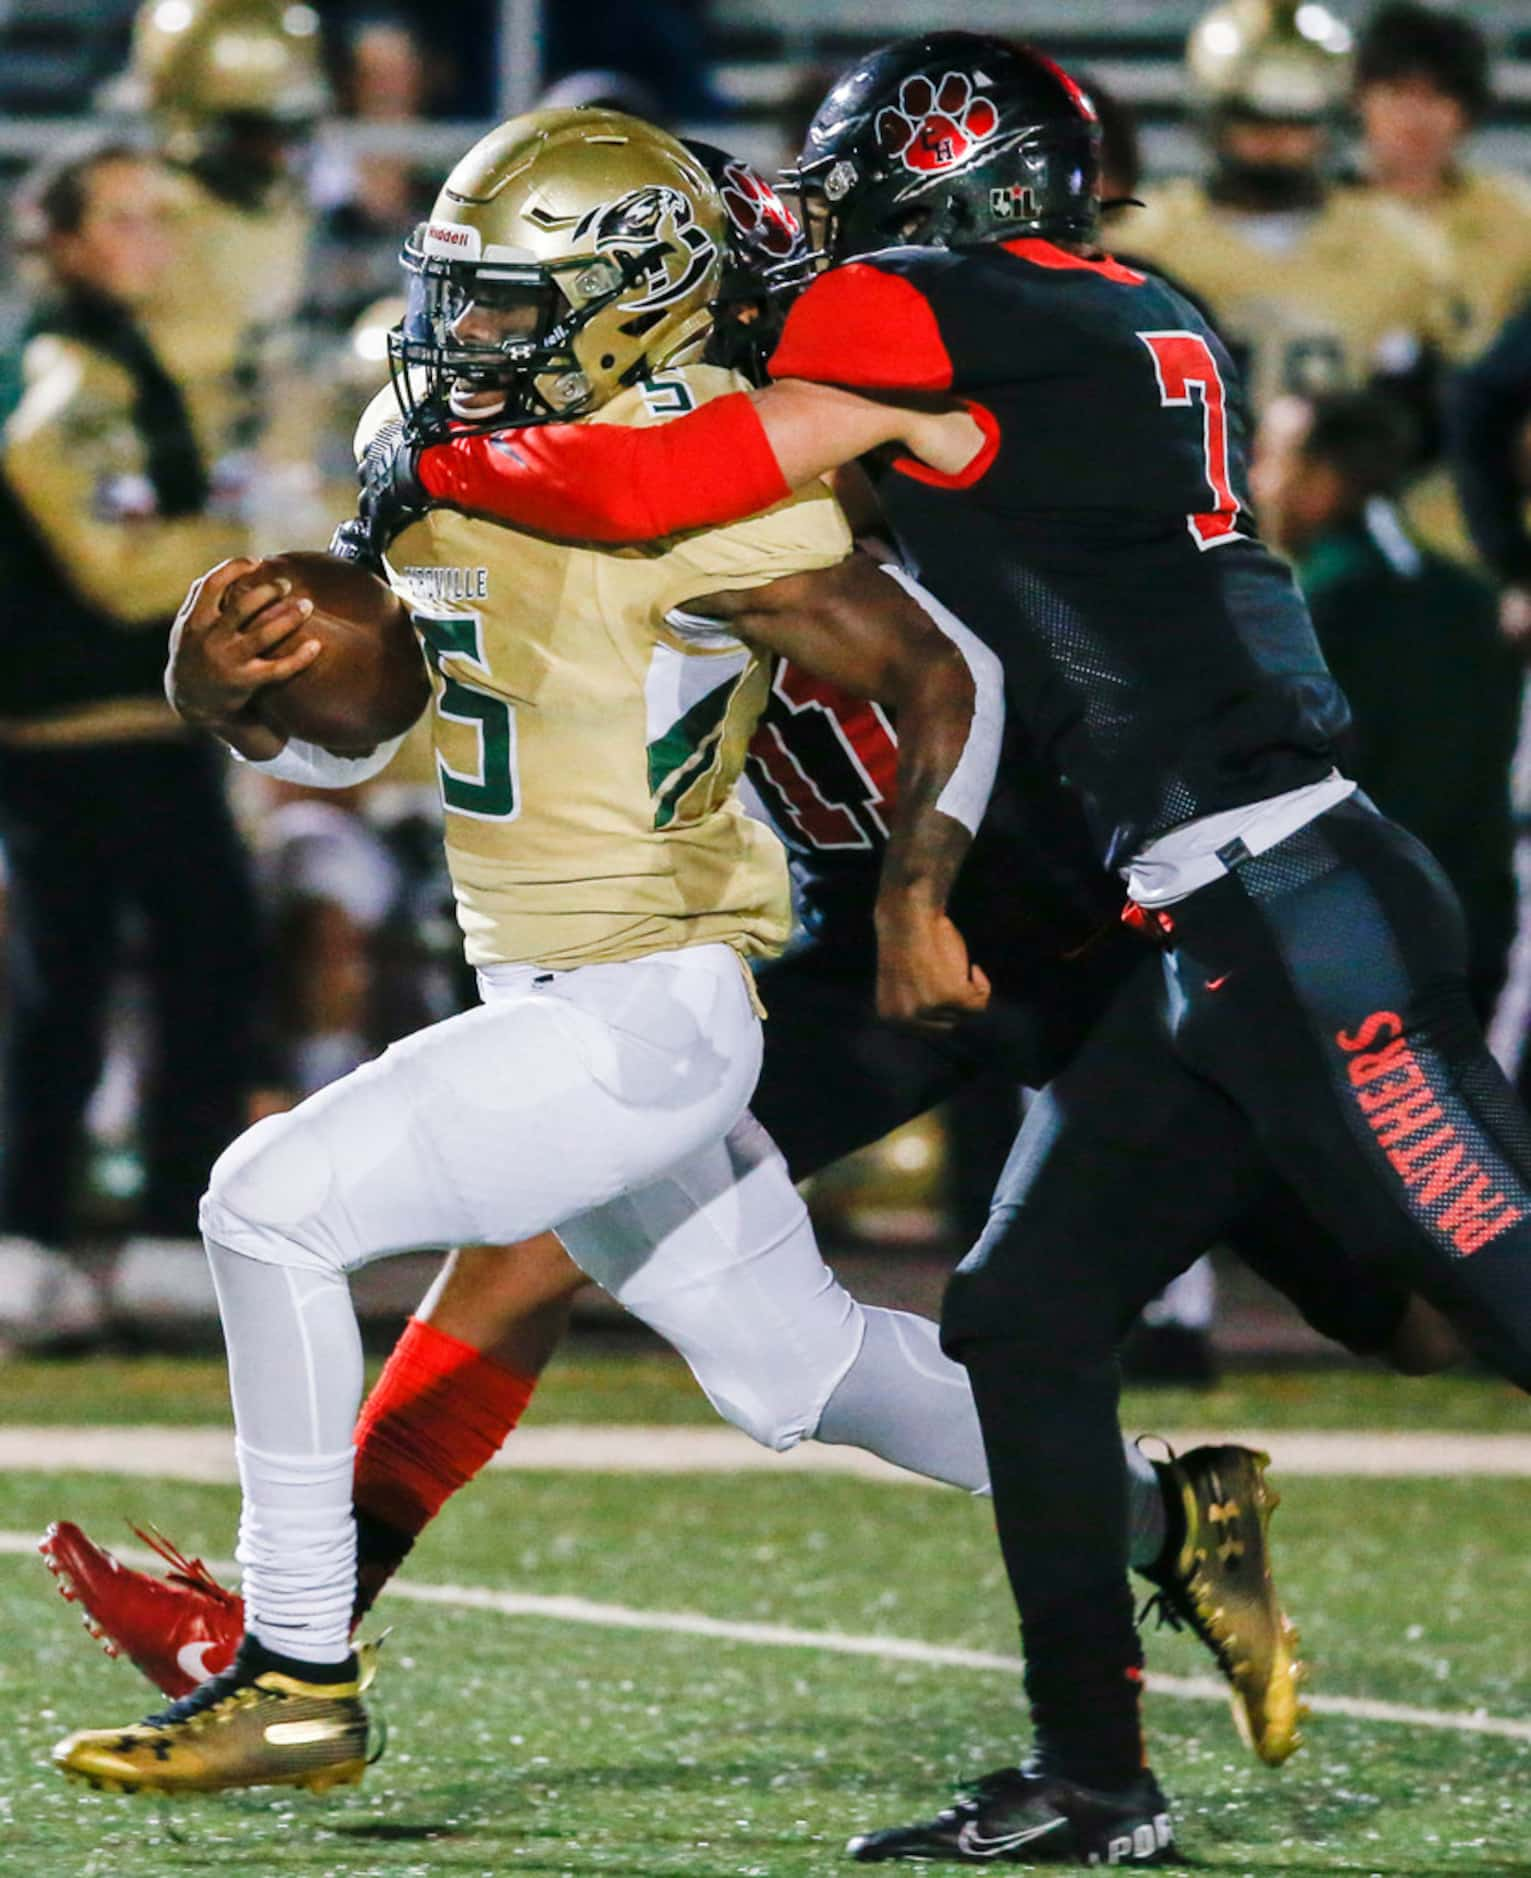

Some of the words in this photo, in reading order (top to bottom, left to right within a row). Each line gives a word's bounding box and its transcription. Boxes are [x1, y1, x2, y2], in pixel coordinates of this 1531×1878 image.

[636, 368, 697, 416] 5
[1135, 329, 1248, 552] 7
[410, 611, 522, 824] 5
[1335, 1010, 1522, 1257] PANTHERS
